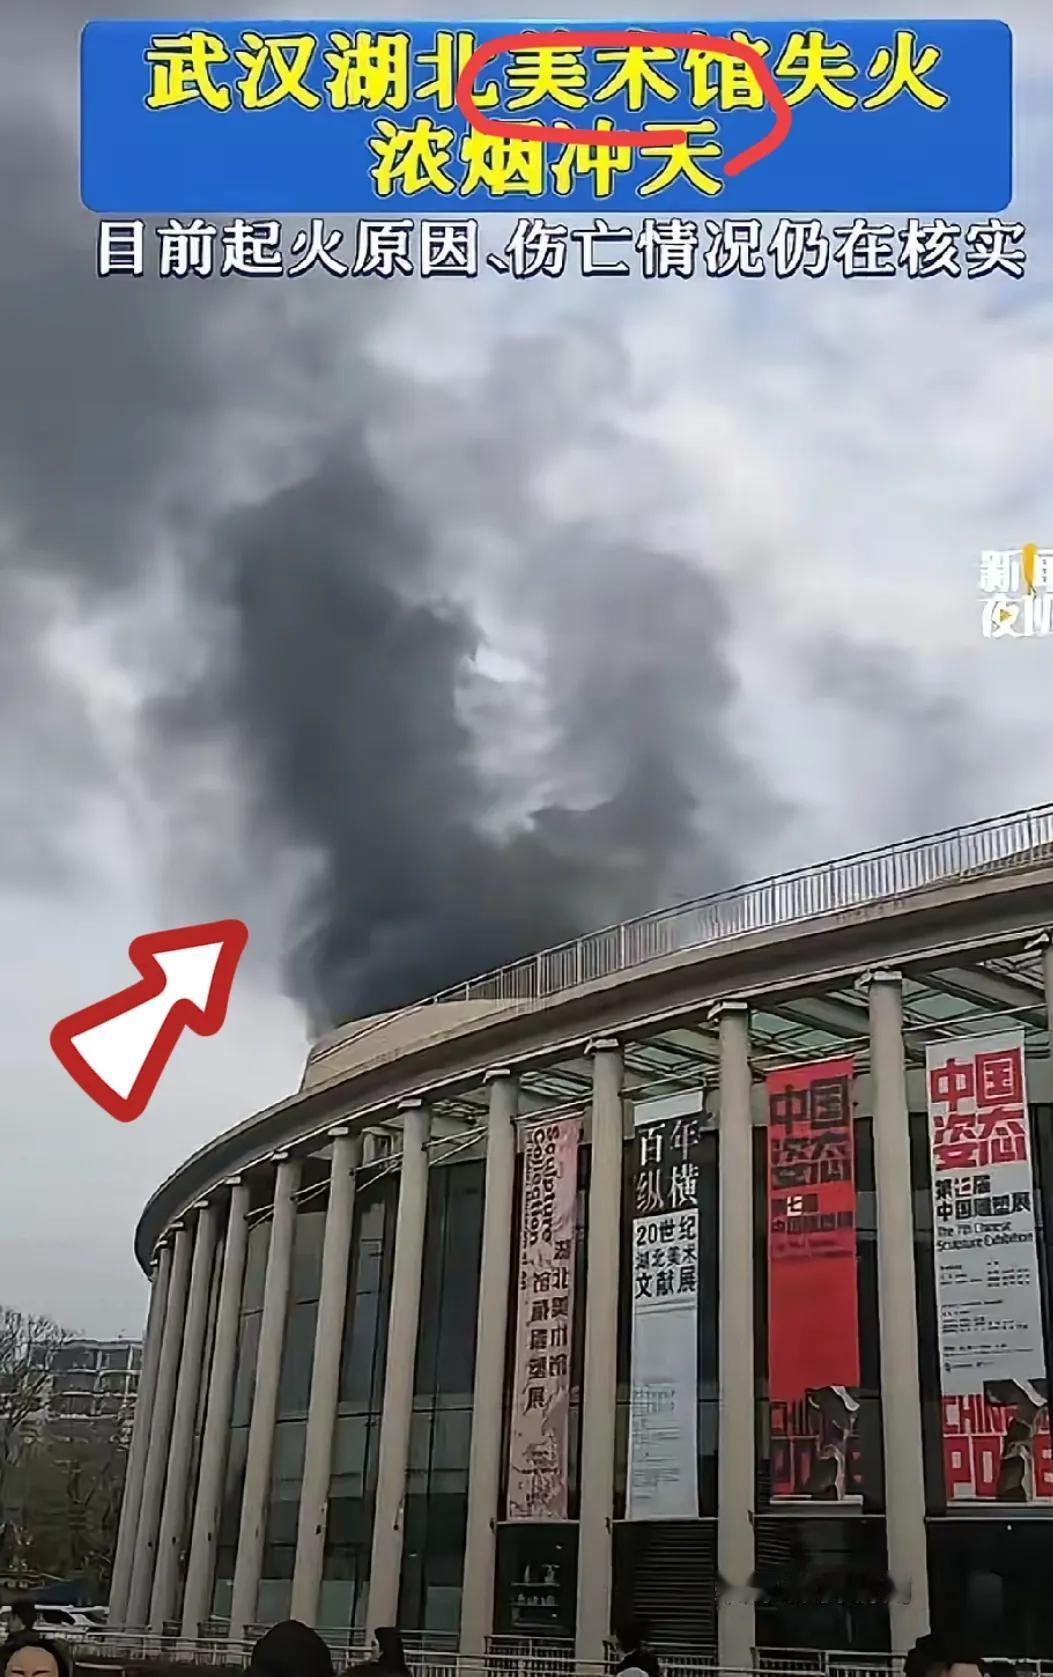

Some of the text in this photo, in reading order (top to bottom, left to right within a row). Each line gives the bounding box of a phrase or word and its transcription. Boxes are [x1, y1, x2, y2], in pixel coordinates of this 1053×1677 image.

[930, 1047, 1023, 1112] 中国
[770, 1075, 850, 1138] 中国
[637, 1119, 699, 1166] 百年
[933, 1108, 1027, 1171] 姿态
[636, 1163, 699, 1212] 纵横
[636, 1215, 696, 1246] 20世纪
[635, 1266, 696, 1300] 文献展
[943, 1393, 1050, 1435] CHIN
